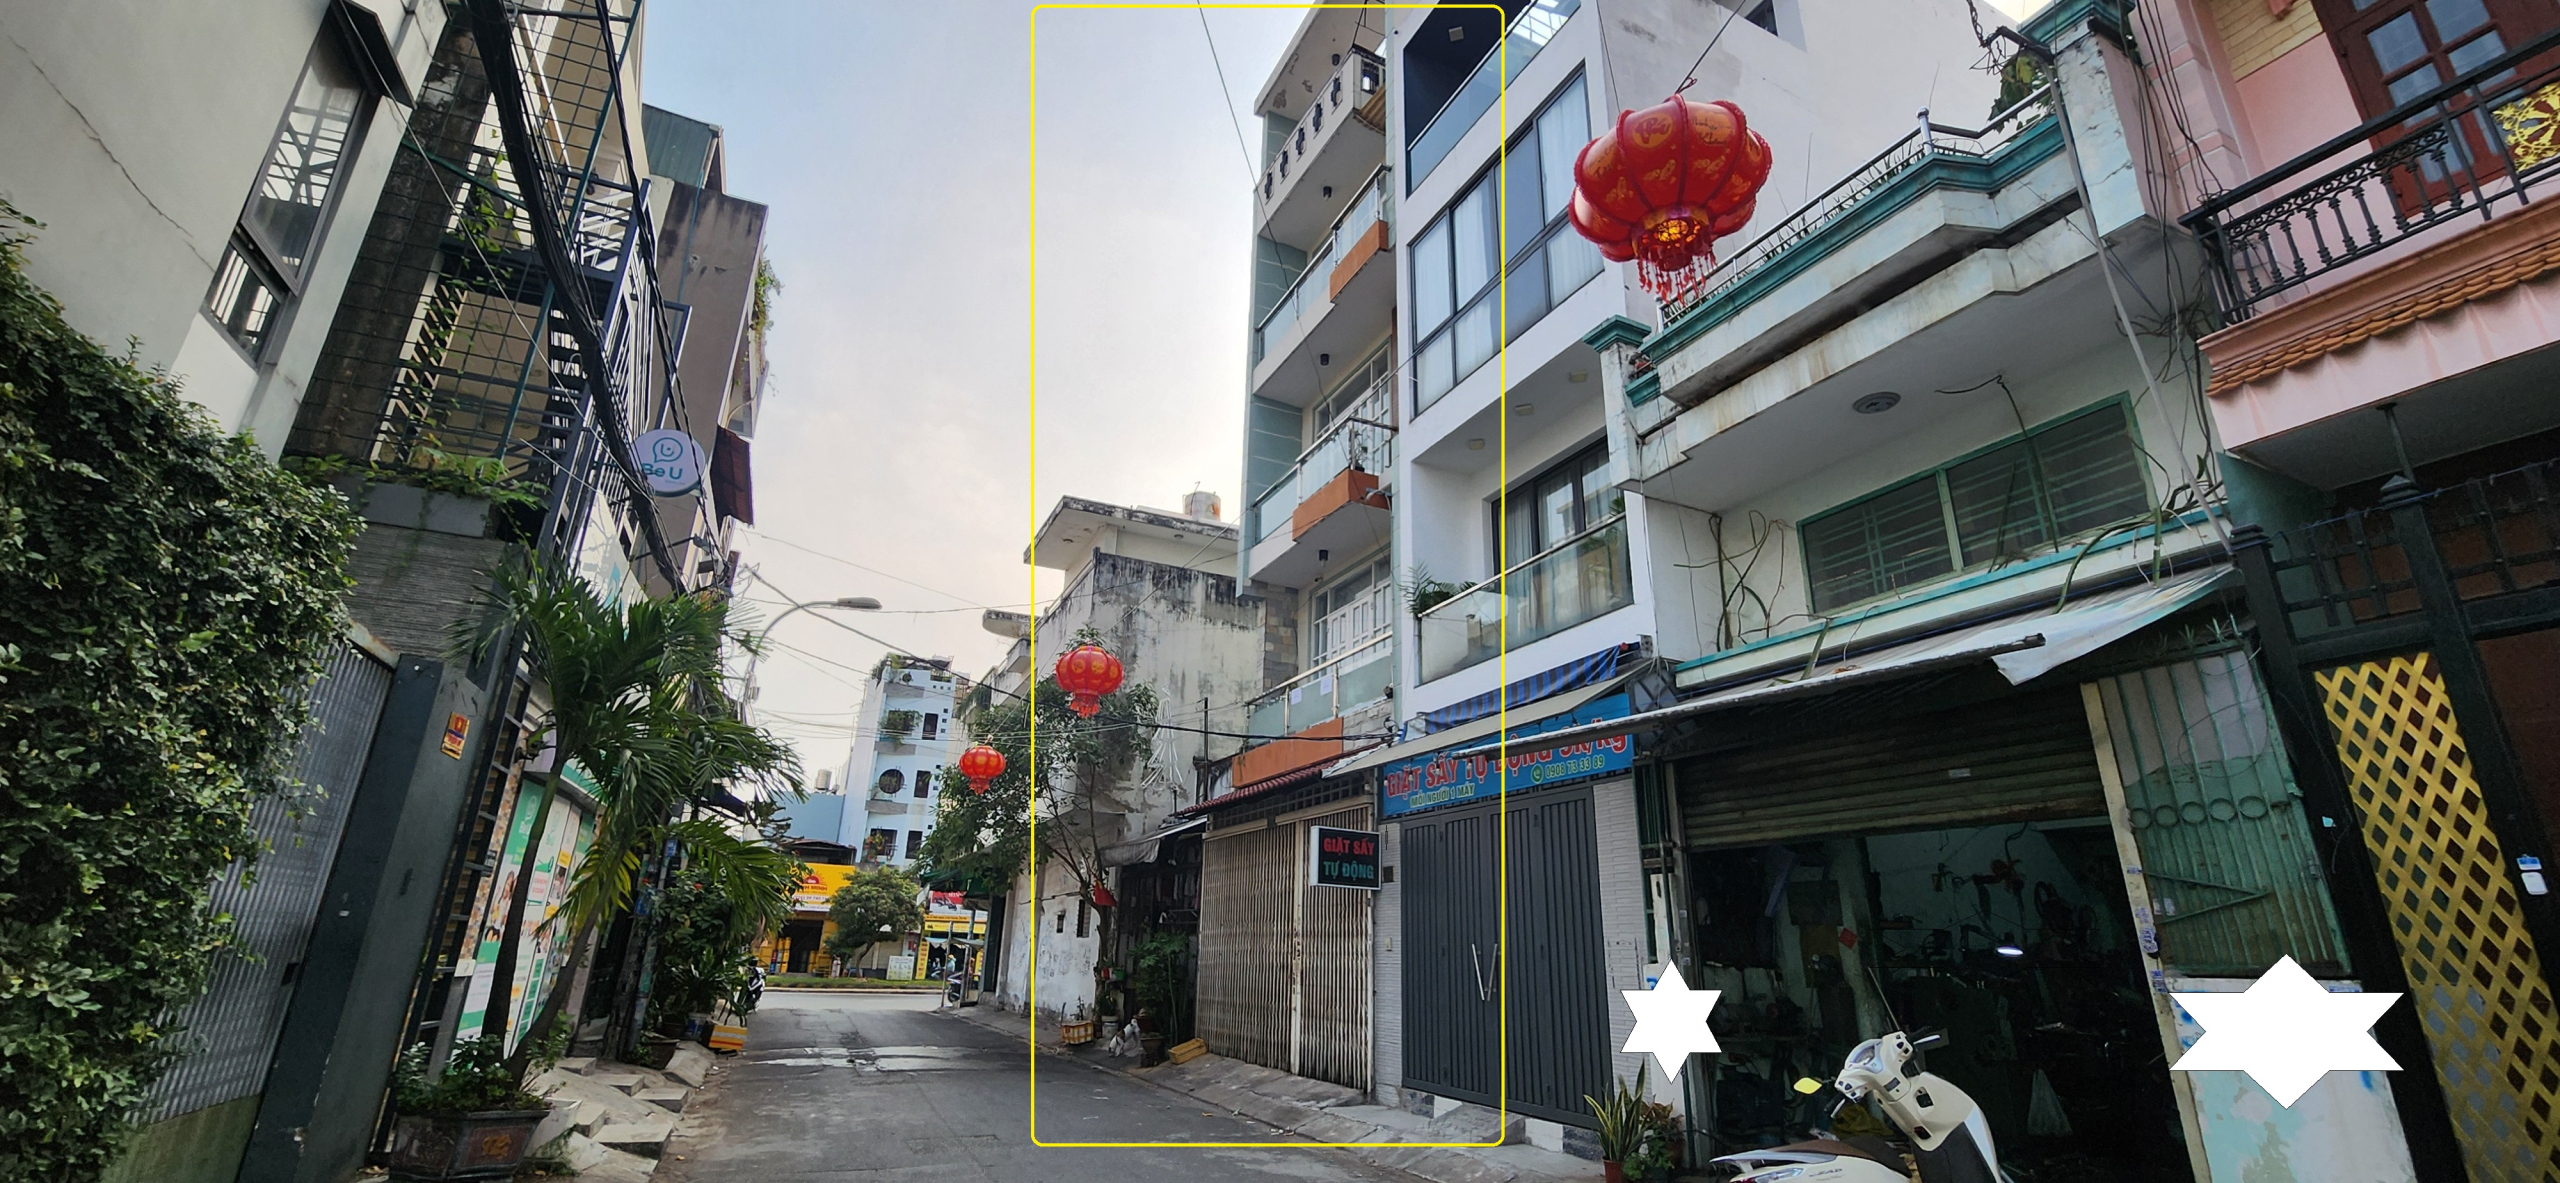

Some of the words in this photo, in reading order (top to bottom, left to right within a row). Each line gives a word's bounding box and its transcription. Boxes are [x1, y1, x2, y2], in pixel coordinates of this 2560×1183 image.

[669, 466, 683, 480] U
[1545, 763, 1565, 778] 0908
[1580, 757, 1591, 771] 33
[1593, 754, 1605, 768] 89
[1450, 786, 1456, 799] 1
[1323, 836, 1350, 855] GIẶT
[1352, 837, 1375, 856] SẤY
[1323, 861, 1339, 879] TỰ
[1342, 861, 1374, 880] ĐỘNG
